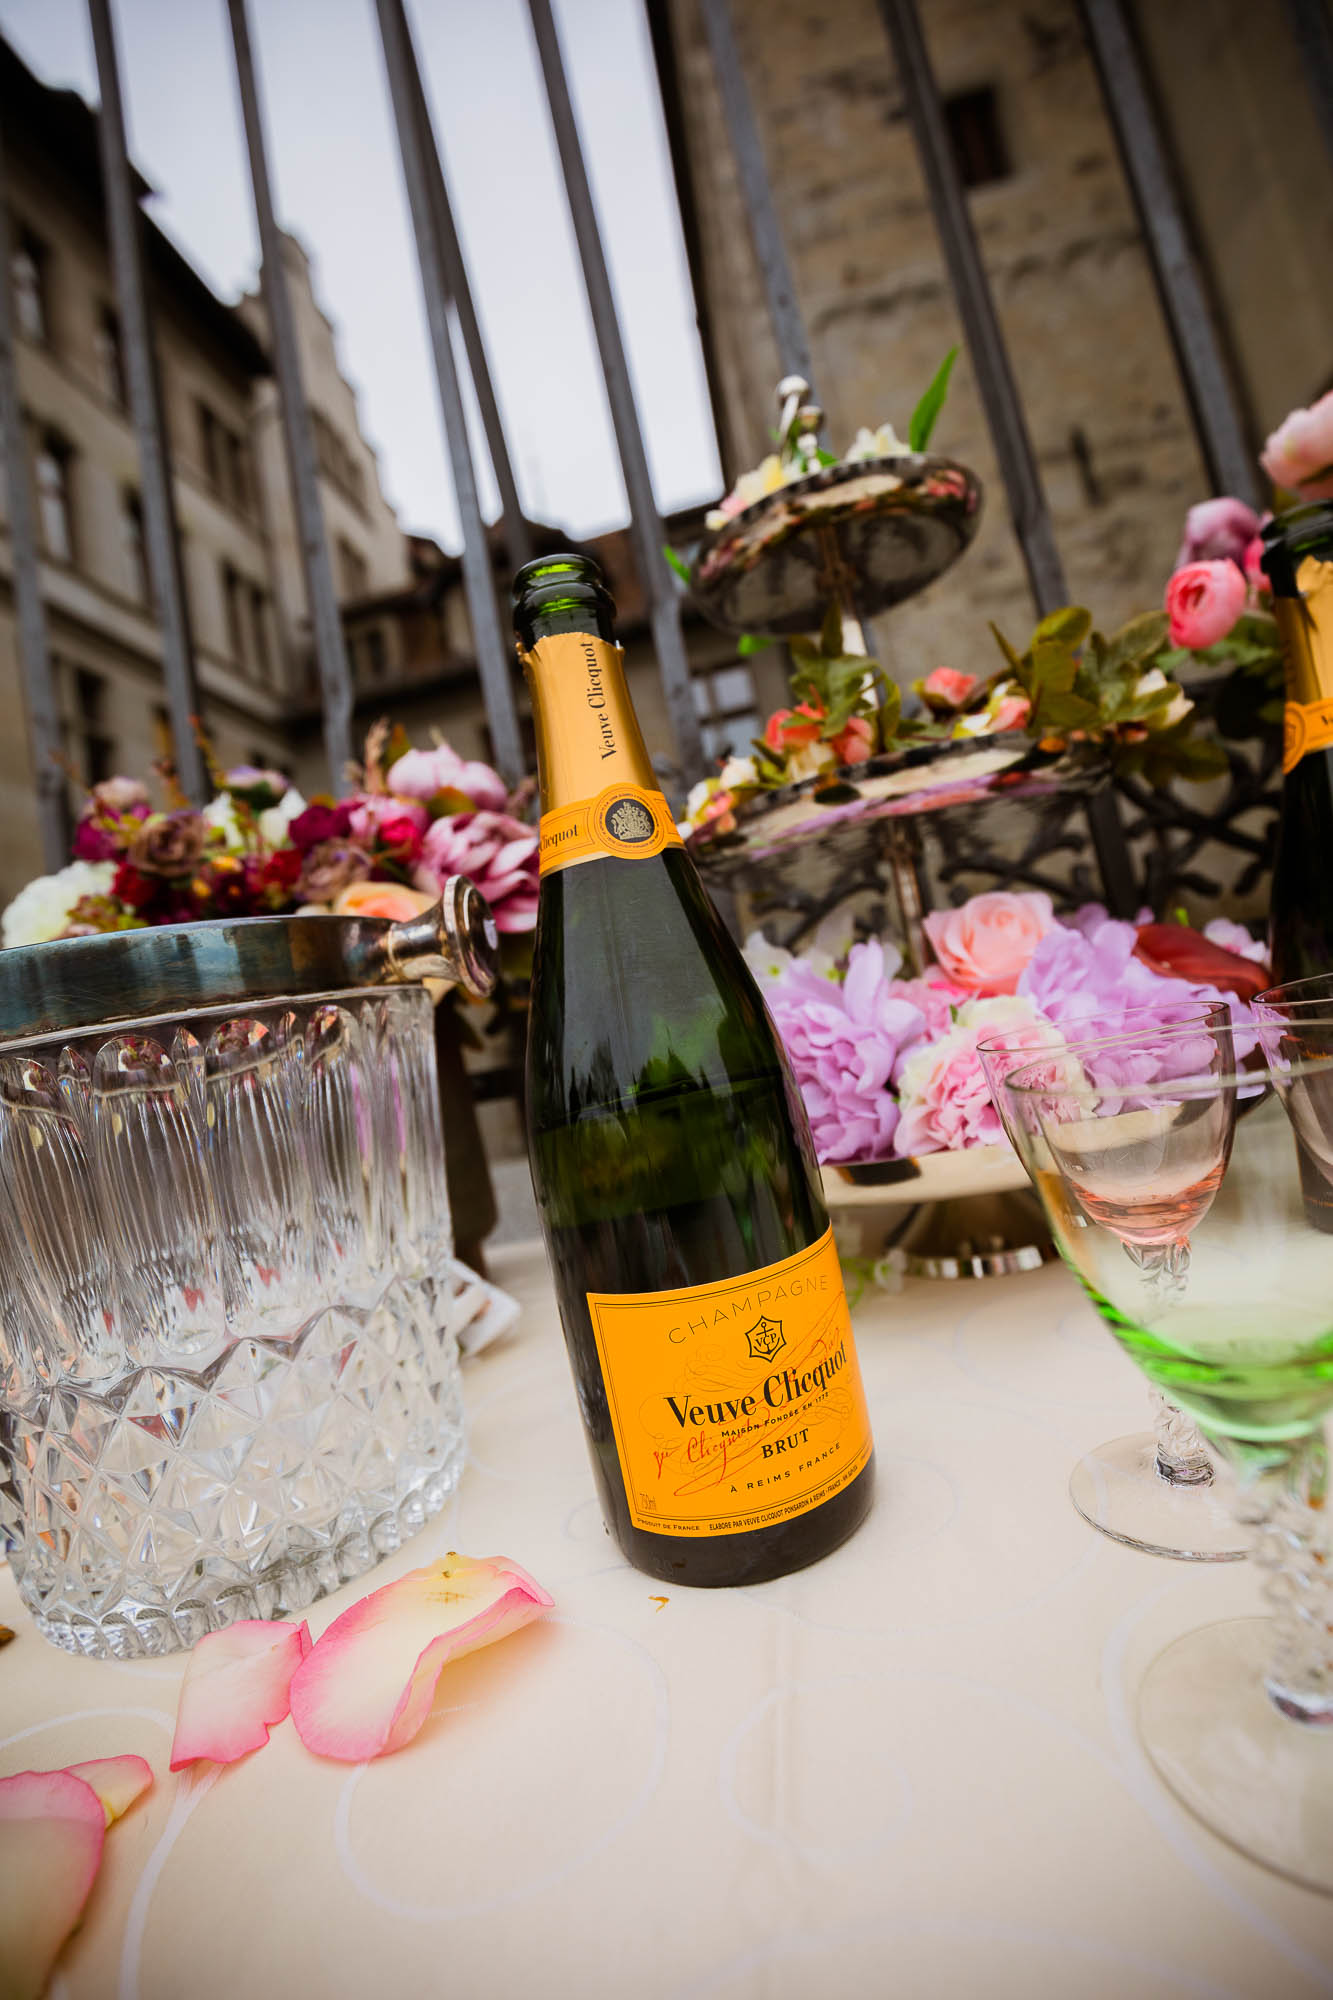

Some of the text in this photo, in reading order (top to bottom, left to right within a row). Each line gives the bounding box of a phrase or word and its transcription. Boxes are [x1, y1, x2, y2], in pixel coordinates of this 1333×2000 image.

[580, 642, 617, 760] Veuve Clicquot
[668, 1275, 828, 1344] CHAMPAGNE
[663, 1339, 847, 1428] Veuve Clicquot
[721, 1423, 760, 1438] MAISON
[802, 1402, 813, 1411] EN
[761, 1427, 809, 1459] BRUT
[746, 1470, 791, 1490] REIMS
[798, 1441, 840, 1472] FRANCE
[673, 1523, 700, 1531] FRANCE
[732, 1519, 743, 1528] PAR
[742, 1516, 760, 1526] VEUVE
[760, 1509, 784, 1522] CLICQUOT
